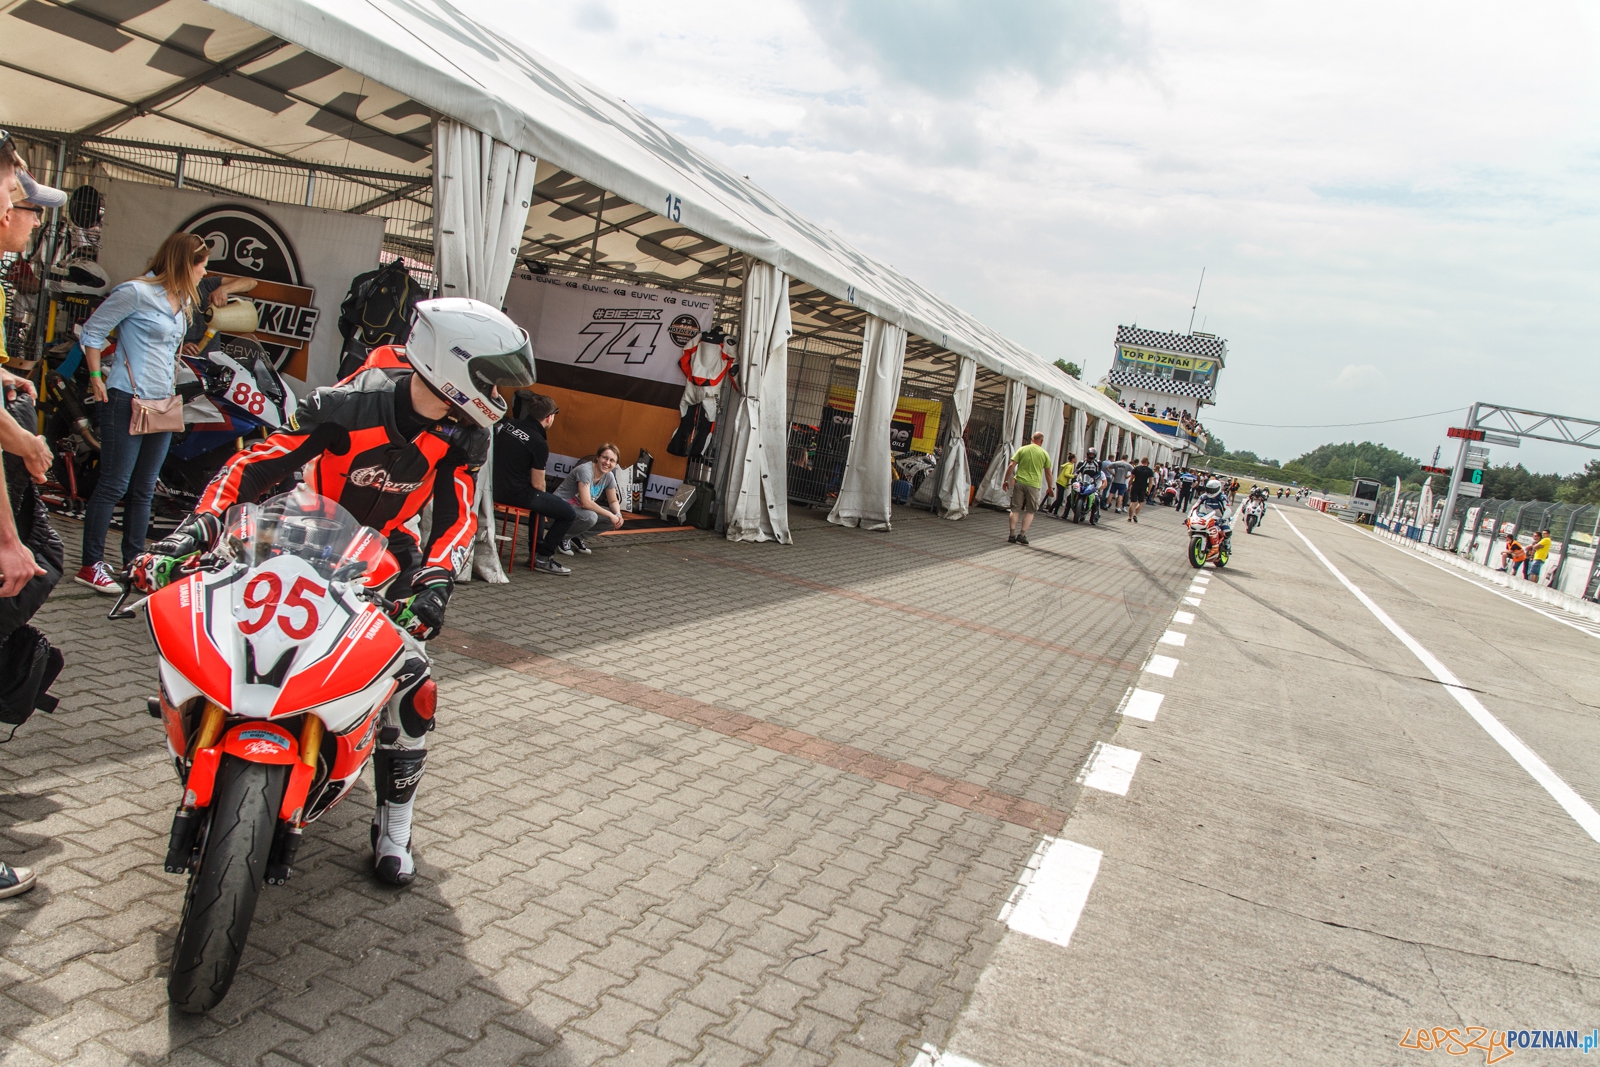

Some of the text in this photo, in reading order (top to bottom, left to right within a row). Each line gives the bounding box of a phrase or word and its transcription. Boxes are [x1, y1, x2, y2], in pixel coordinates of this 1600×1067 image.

[665, 193, 682, 223] 15
[846, 284, 856, 304] 14
[593, 308, 663, 320] #BIESIEK
[574, 322, 663, 364] 74
[1123, 349, 1190, 367] TOR POZNAŃ
[232, 382, 266, 415] 88
[637, 462, 648, 478] 74
[1471, 469, 1482, 484] 6
[179, 583, 190, 608] YAMAHA
[237, 571, 326, 640] 95
[364, 618, 385, 640] YAMAHA
